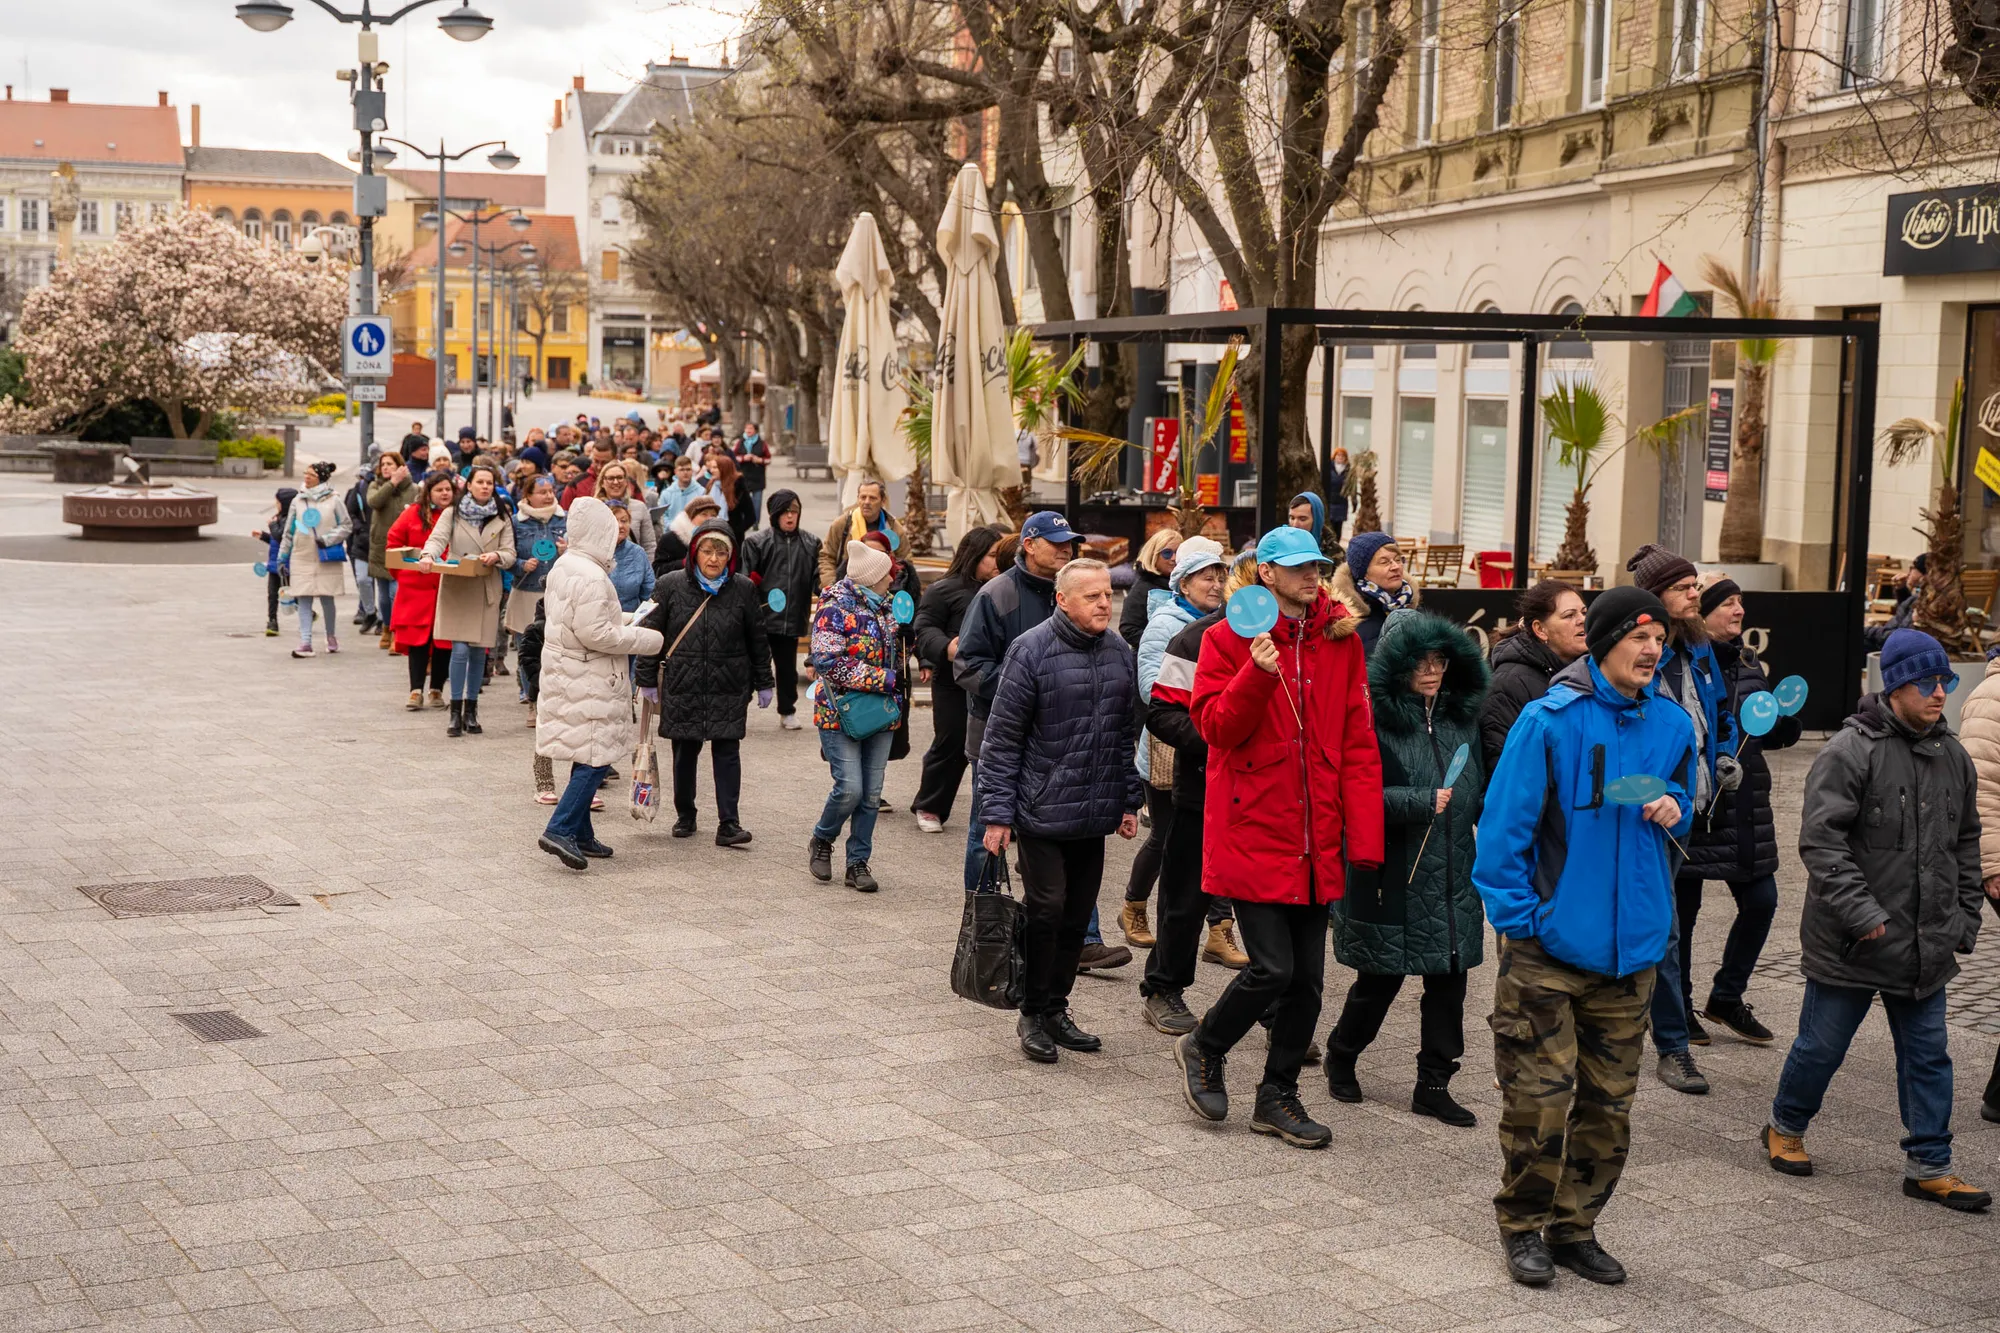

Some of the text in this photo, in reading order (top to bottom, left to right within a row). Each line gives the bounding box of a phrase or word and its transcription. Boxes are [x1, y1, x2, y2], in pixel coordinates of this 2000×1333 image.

[1901, 198, 1953, 250] Lipóti
[356, 360, 382, 370] ZÓNA
[115, 505, 193, 519] COLONIA
